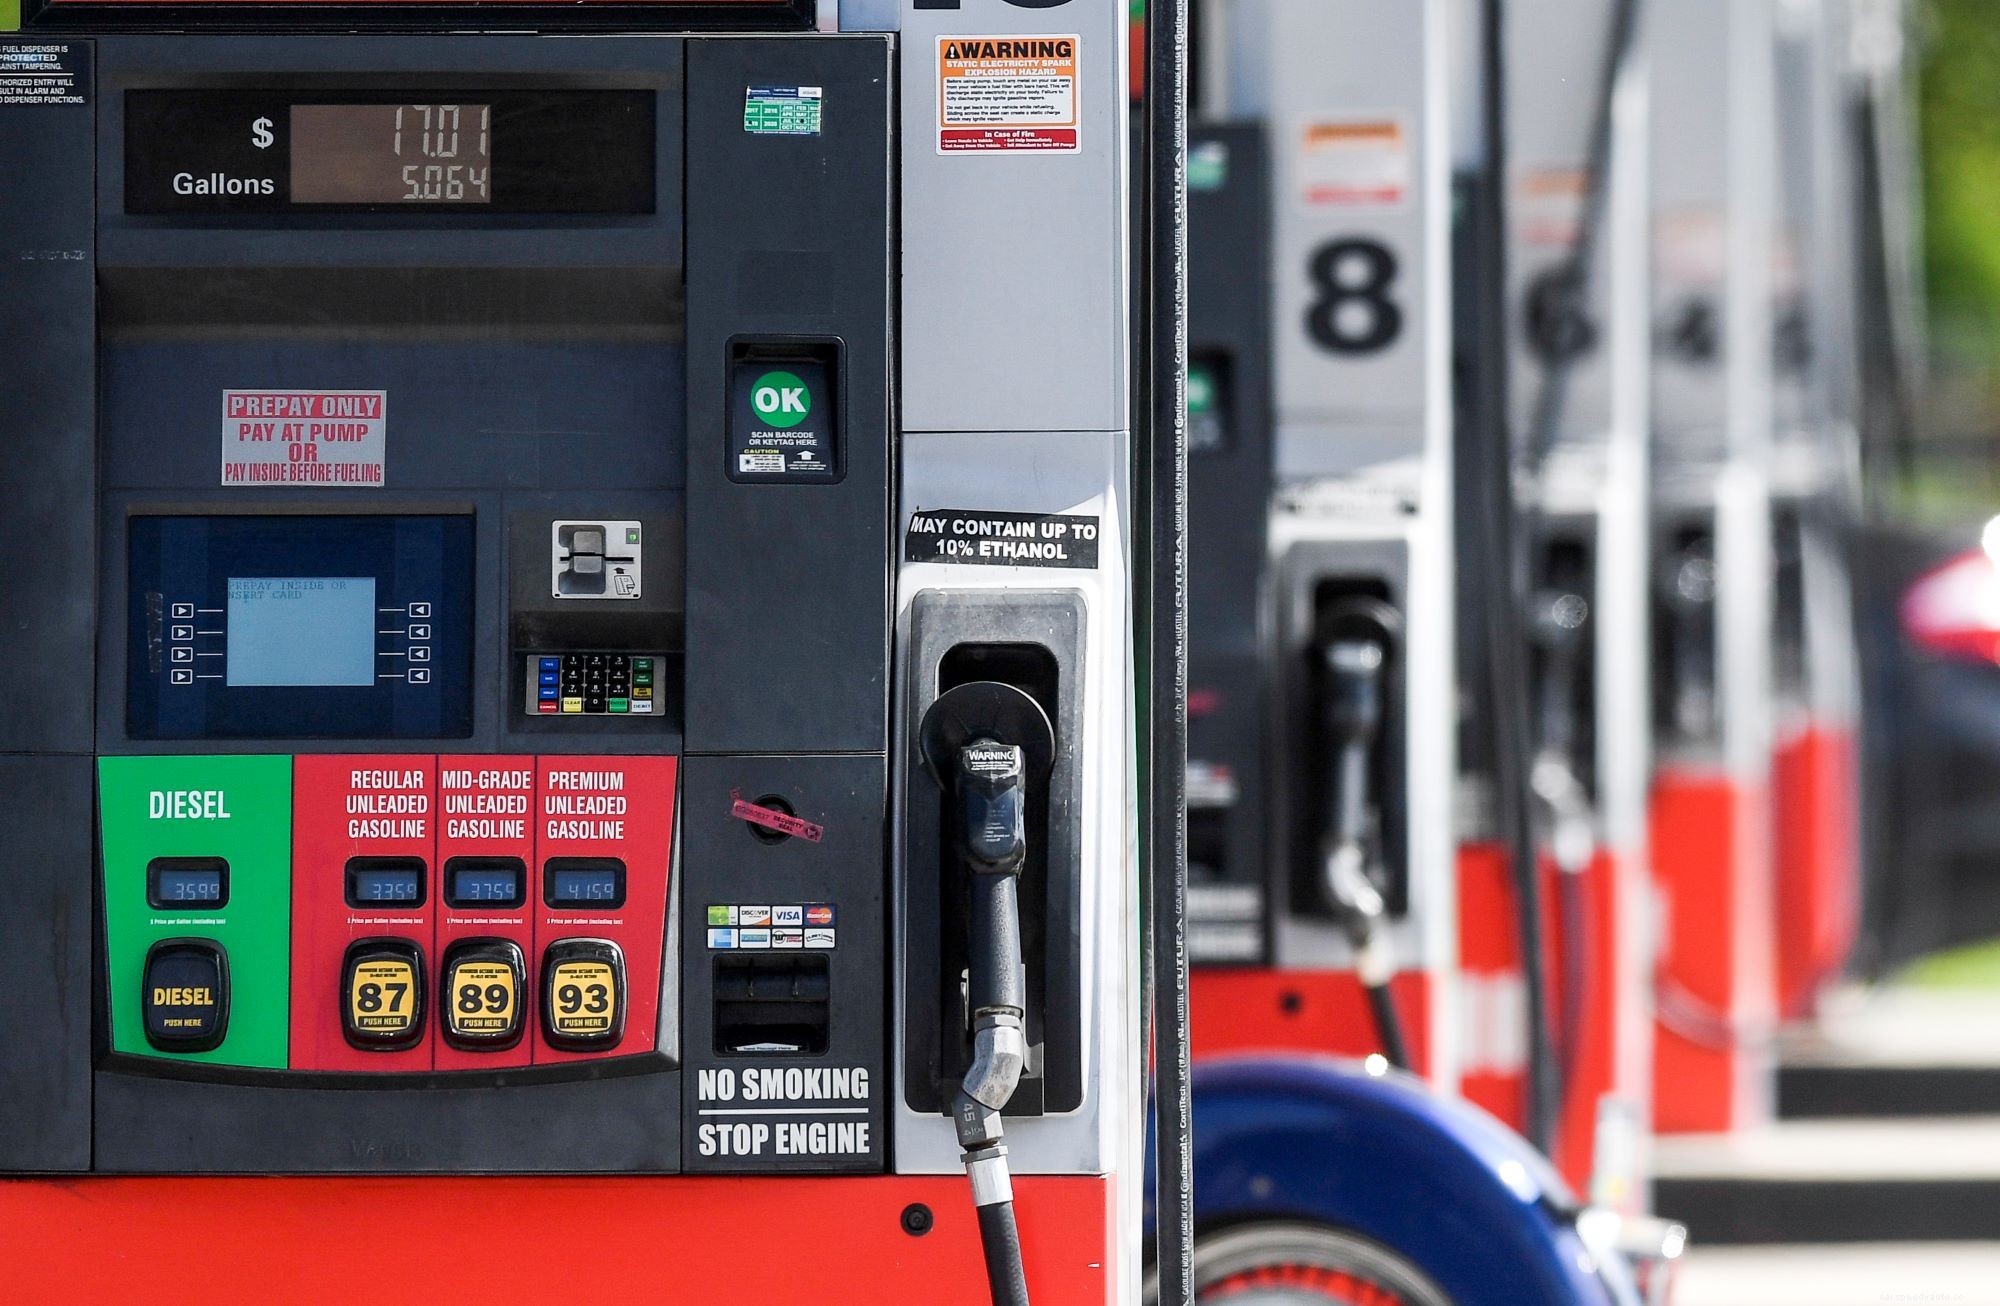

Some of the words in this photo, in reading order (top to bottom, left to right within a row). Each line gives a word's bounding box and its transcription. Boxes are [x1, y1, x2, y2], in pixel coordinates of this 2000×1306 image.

[2, 45, 20, 53] FUEL
[21, 45, 60, 53] DISPENSER
[61, 45, 68, 53] IS
[960, 40, 1072, 59] WARNING
[946, 60, 978, 68] STATIC
[980, 60, 1040, 68] ELECTRICITY
[1042, 60, 1072, 68] SPARK
[964, 68, 1017, 76] EXPLOSION
[1018, 68, 1057, 76] HAZARD
[252, 116, 274, 149] $
[394, 104, 489, 158] 17.01
[172, 172, 275, 196] Gallons
[402, 165, 488, 200] 5.064
[1305, 233, 1403, 355] 8
[231, 396, 316, 416] PREPAY
[322, 396, 377, 416] ONLY
[755, 387, 806, 413] OK
[239, 424, 274, 442] PAY
[281, 424, 304, 442] AT
[310, 424, 368, 442] PUMP
[288, 443, 318, 462] OR
[225, 463, 246, 482] PAY
[250, 463, 286, 482] INSIDE
[289, 463, 332, 482] BEFORE
[334, 463, 381, 482] FUELING
[910, 516, 947, 534] MAY
[952, 520, 1036, 536] CONTAIN
[1041, 523, 1066, 539] UP
[1072, 524, 1096, 540] TO
[936, 539, 974, 556] 10%
[979, 541, 1068, 560] ETHANOL
[968, 750, 1015, 761] WARNING
[351, 770, 424, 789] REGULAR
[442, 770, 531, 789] MID-GRADE
[548, 772, 624, 790] PREMIUM
[149, 790, 230, 819] DIESEL
[346, 795, 428, 814] UNLEADED
[445, 795, 527, 814] UNLEADED
[545, 796, 626, 814] UNLEADED
[348, 820, 426, 838] GASOLINE
[447, 820, 524, 839] GASOLINE
[547, 820, 624, 839] GASOLINE
[776, 912, 800, 920] VISA
[1176, 918, 1184, 990] FUTURA
[154, 988, 213, 1006] DIESEL
[357, 983, 408, 1013] 87
[458, 984, 509, 1014] 89
[558, 984, 609, 1014] 93
[164, 1019, 182, 1027] PUSH
[184, 1019, 202, 1027] HERE
[363, 1017, 381, 1026] PUSH
[383, 1017, 401, 1026] HERE
[464, 1019, 481, 1027] PUSH
[484, 1019, 502, 1027] HERE
[564, 1018, 581, 1027] PUSH
[584, 1018, 602, 1027] HERE
[698, 1068, 735, 1100] NO
[742, 1067, 869, 1100] SMOKING
[964, 1103, 976, 1122] 45
[1179, 1086, 1187, 1129] ContiTech
[698, 1124, 769, 1155] STOP
[776, 1122, 870, 1154] ENGINE
[1180, 1142, 1189, 1192] Continental
